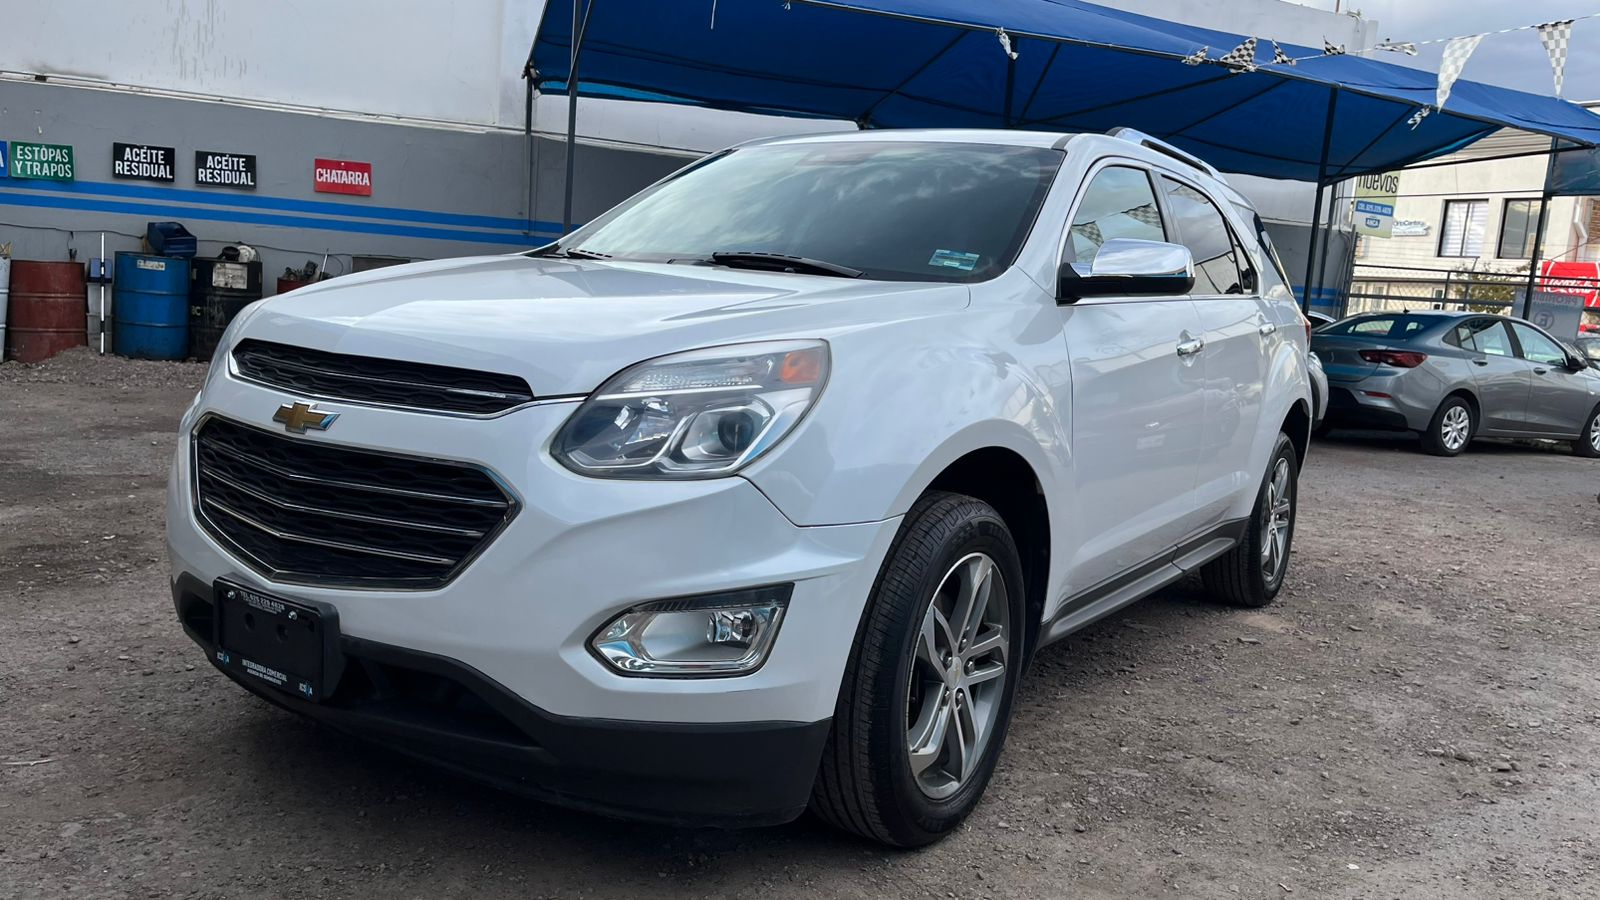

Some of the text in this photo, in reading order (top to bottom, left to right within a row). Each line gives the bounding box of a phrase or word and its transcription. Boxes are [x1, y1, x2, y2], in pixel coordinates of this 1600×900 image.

[15, 160, 72, 178] Y TRAPOS
[115, 161, 173, 179] RESIDUAL
[198, 168, 255, 185] RESIDUAL
[316, 168, 370, 186] CHATARRA
[266, 666, 288, 682] COMERCIAL
